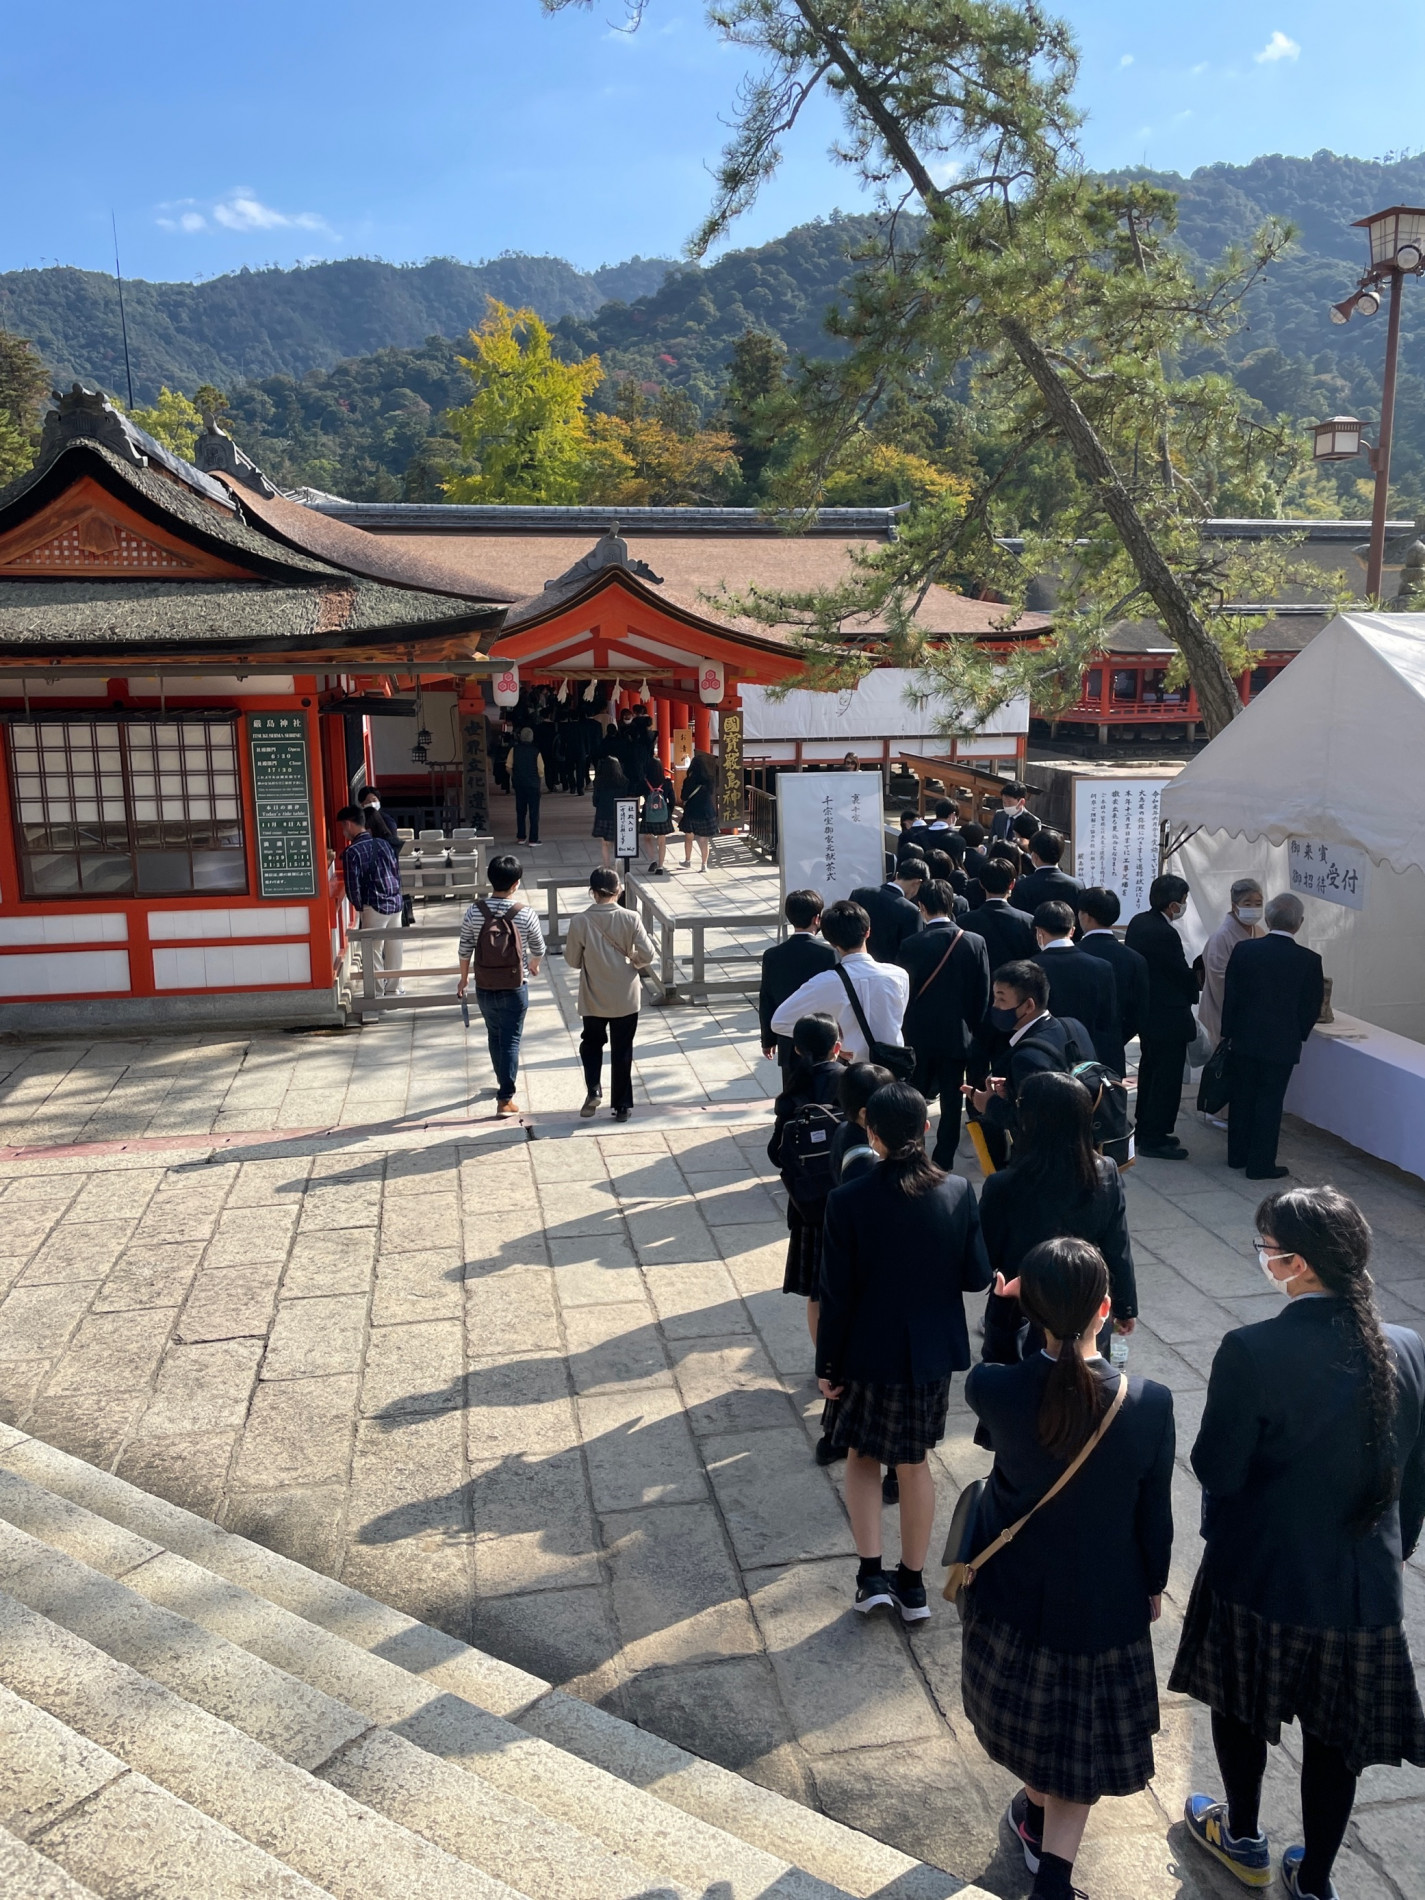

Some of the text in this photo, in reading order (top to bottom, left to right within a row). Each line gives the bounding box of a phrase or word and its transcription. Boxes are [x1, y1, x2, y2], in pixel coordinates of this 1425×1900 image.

[1291, 840, 1328, 864] 御来賓
[1293, 869, 1327, 894] 御招待
[1327, 862, 1358, 894] 受付
[1206, 1818, 1221, 1845] N
